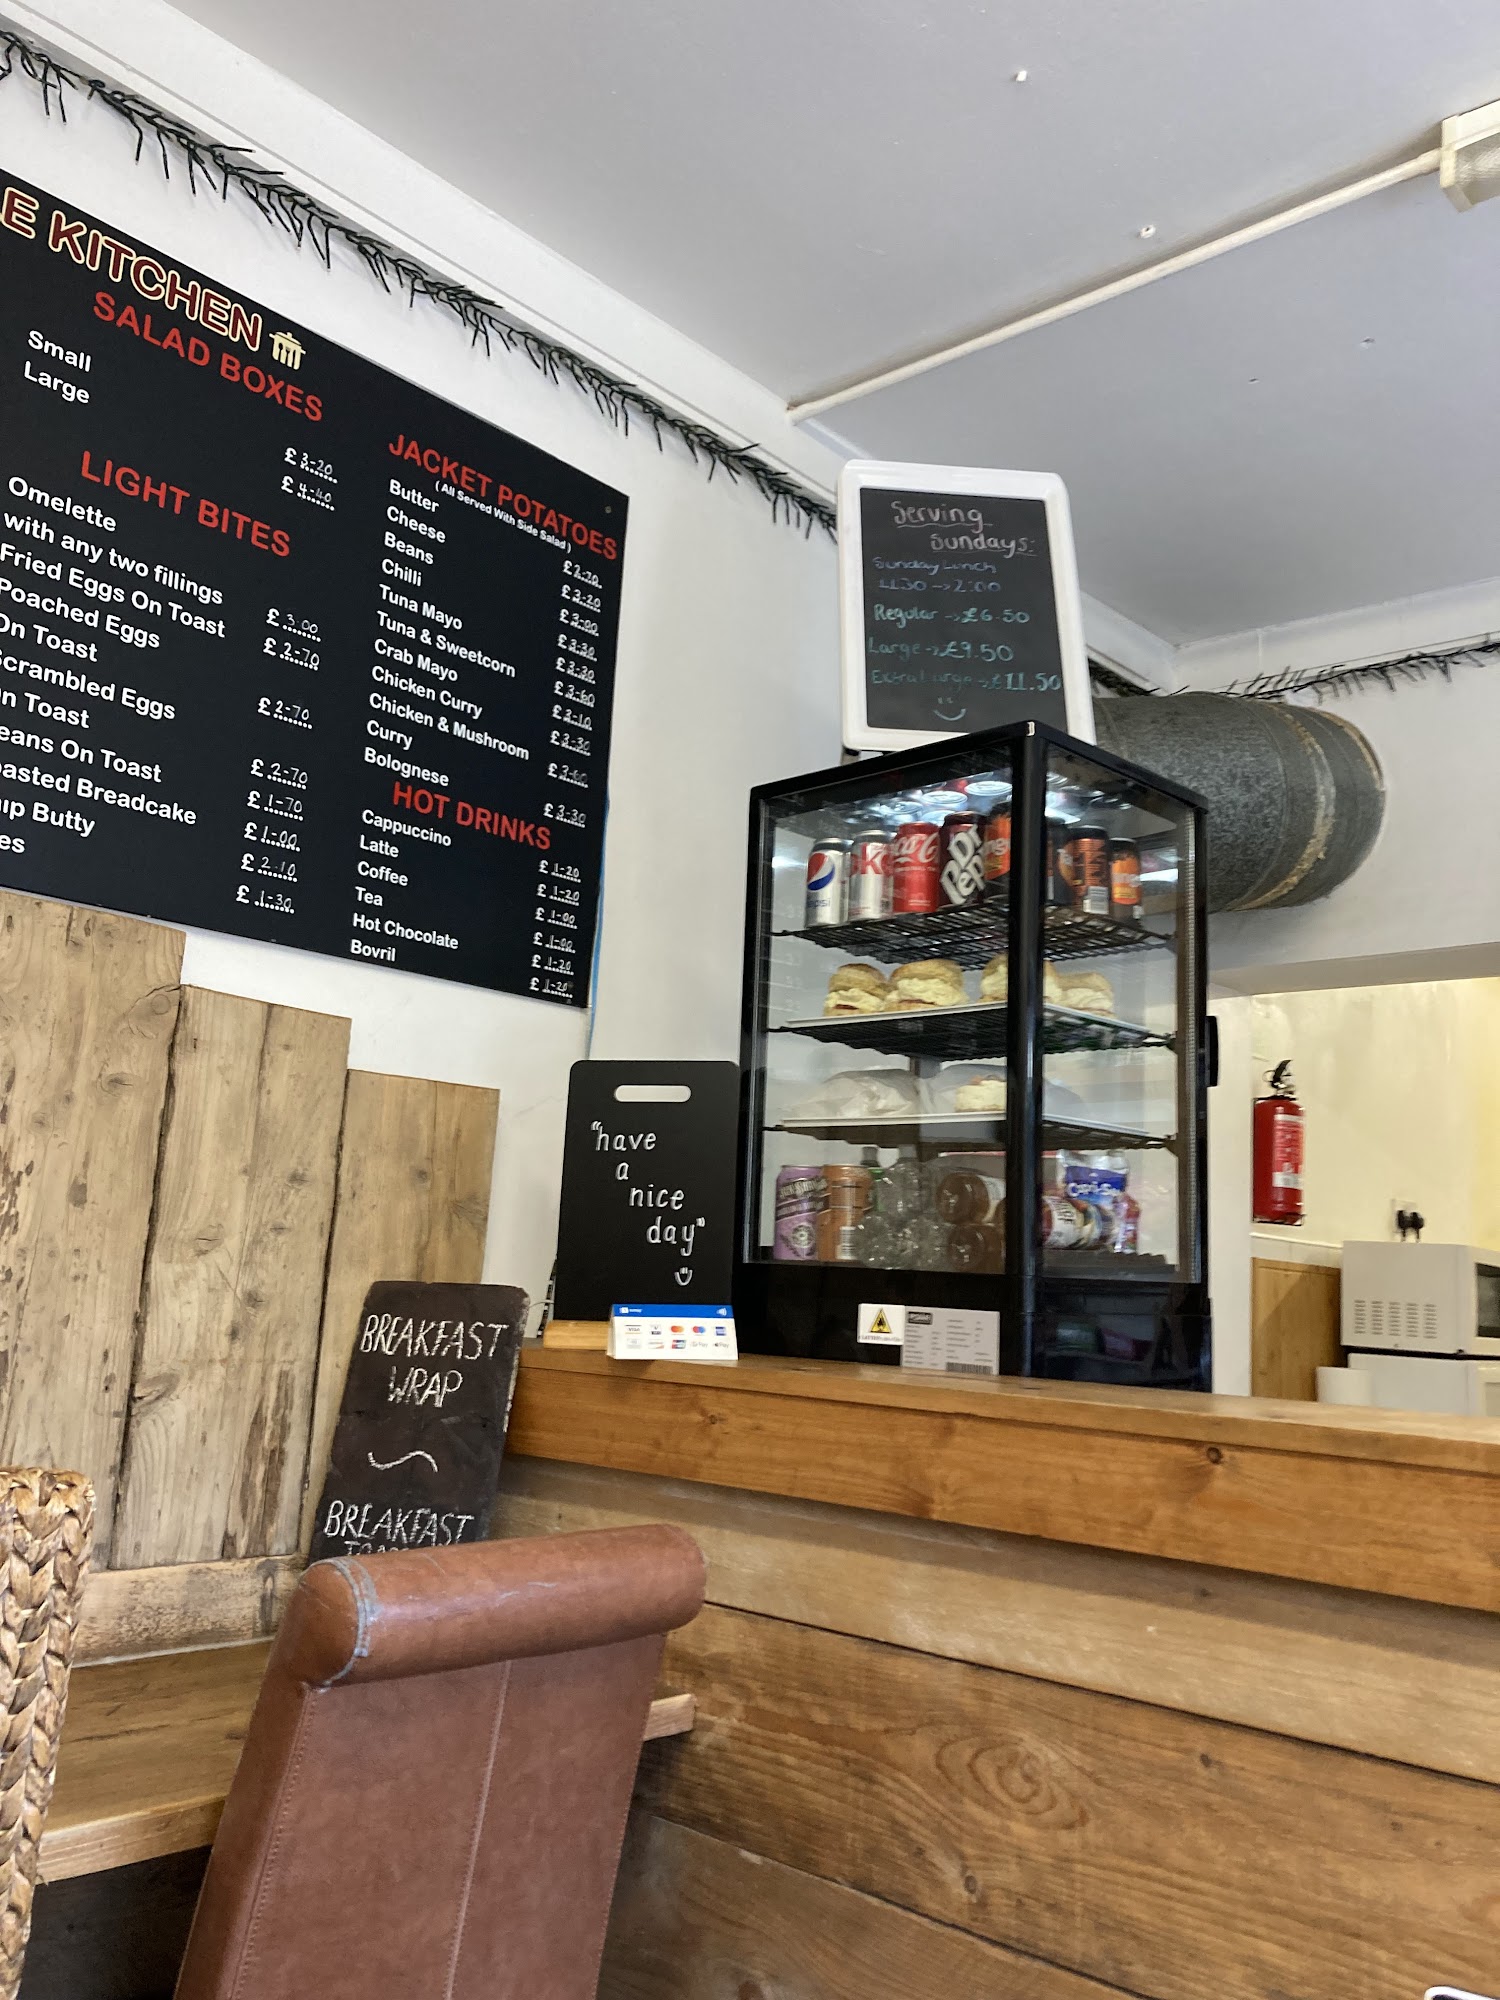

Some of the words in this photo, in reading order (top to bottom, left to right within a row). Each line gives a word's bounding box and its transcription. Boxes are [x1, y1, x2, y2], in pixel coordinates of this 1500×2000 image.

[48, 210, 262, 351] KITCHEN
[27, 330, 92, 373] Small
[93, 291, 211, 366] SALAD
[220, 353, 323, 421] BOXES
[24, 361, 91, 404] Large
[8, 476, 117, 532] Omelette
[81, 450, 190, 515] LIGHT
[198, 500, 291, 557] BITES
[388, 434, 493, 498] JACKET
[497, 484, 617, 560] POTATOES
[389, 479, 440, 513] Butter
[457, 490, 492, 515] Served
[493, 507, 515, 526] With
[517, 518, 539, 538] Side
[891, 500, 983, 533] Serving
[386, 505, 446, 544] Cheese
[4, 512, 55, 543] with
[61, 535, 104, 564] any
[109, 548, 149, 577] two
[154, 565, 223, 605] fillings
[384, 531, 434, 565] Beans
[872, 556, 939, 576] Sunday
[0, 543, 62, 581] Fried
[68, 567, 125, 603] Eggs
[131, 591, 162, 616] On
[168, 602, 226, 638] Toast
[381, 558, 422, 587] Chilli
[0, 578, 99, 628] Poached
[105, 614, 160, 649] Eggs
[379, 584, 418, 613] Tuna
[422, 602, 463, 631] Mayo
[873, 603, 940, 629] Regular
[33, 624, 98, 662] Toast
[374, 638, 414, 665] Crab
[417, 654, 458, 682] Mayo
[376, 611, 416, 639] Tuna
[420, 629, 432, 645] &
[435, 635, 516, 678] Sweetcorn
[868, 636, 922, 662] Large
[0, 687, 16, 708] n
[24, 693, 89, 729] Toast
[121, 688, 176, 720] Eggs
[371, 665, 436, 701] Chicken
[439, 690, 483, 720] Curry
[366, 720, 413, 751] Curry
[369, 692, 434, 727] Chicken
[437, 716, 450, 733] &
[453, 721, 530, 761] Mushroom
[60, 739, 94, 765] On
[100, 748, 162, 783] Toast
[364, 746, 450, 787] Bolognese
[0, 763, 70, 793] asted
[77, 778, 197, 825] Breadcake
[392, 781, 450, 819] HOT
[456, 801, 551, 850] DRINKS
[32, 802, 95, 838] Butty
[362, 809, 452, 847] Cappuccino
[359, 834, 400, 858] Latte
[947, 824, 982, 869] Dr
[357, 861, 409, 887] Coffee
[355, 886, 383, 907] Tea
[350, 939, 396, 962] Bovril
[352, 912, 381, 933] Hot
[383, 920, 459, 950] Chocolate
[616, 1162, 630, 1181] a
[628, 1184, 685, 1210] nice
[359, 1313, 510, 1361] BREAKFAST
[387, 1365, 463, 1408] WRAP
[323, 1500, 475, 1546] BREAKFAST
